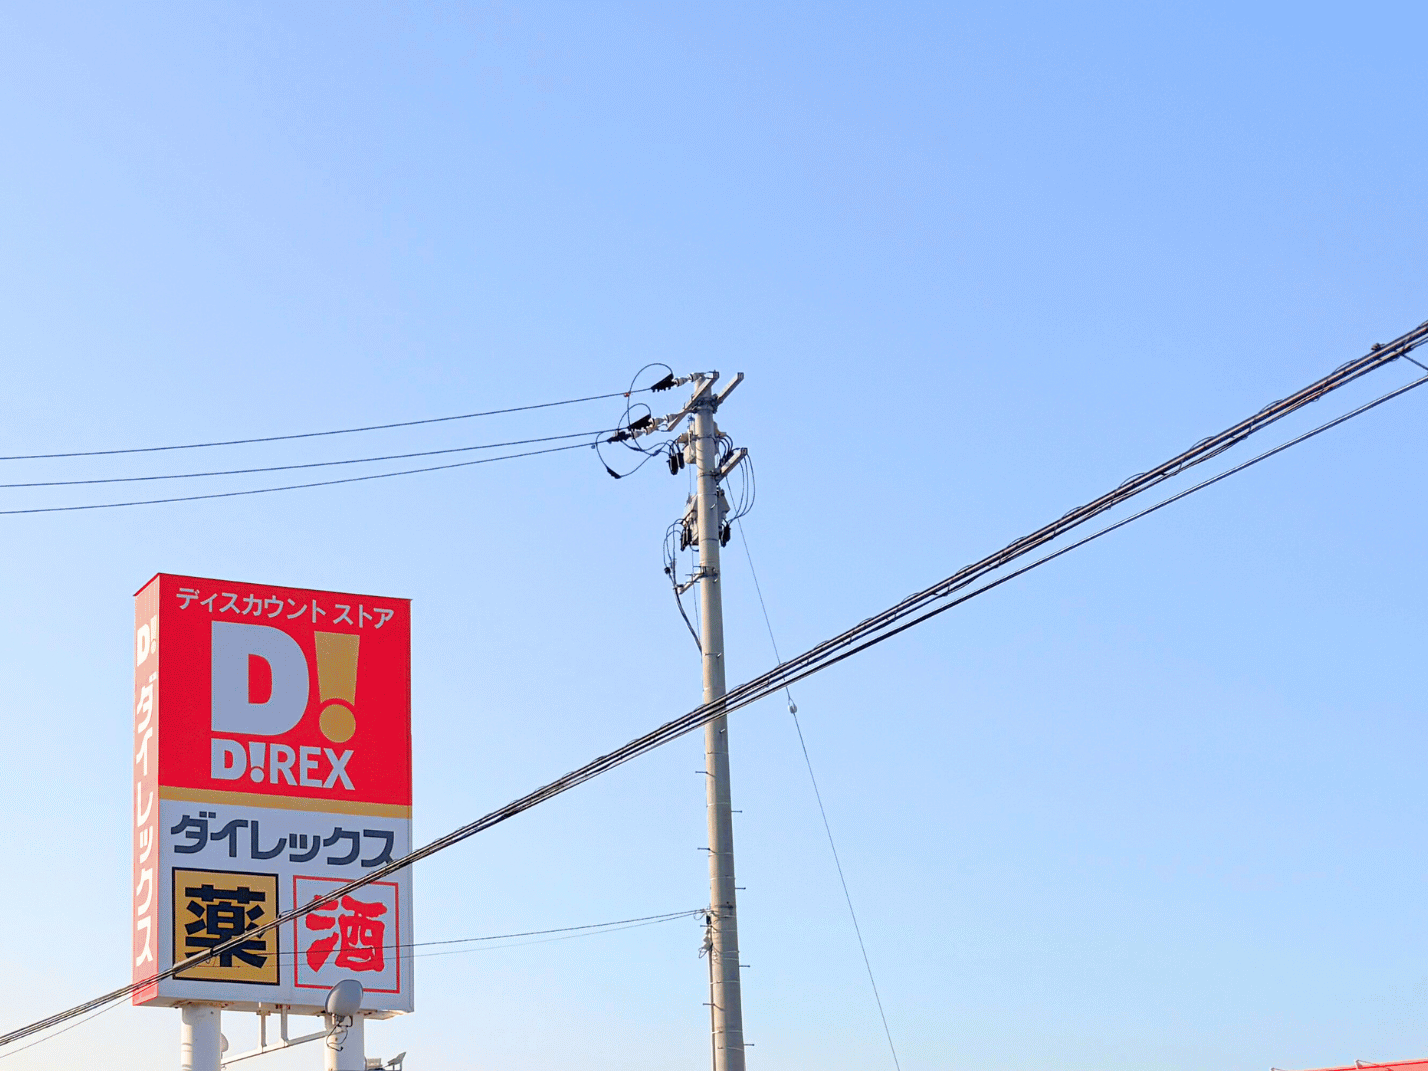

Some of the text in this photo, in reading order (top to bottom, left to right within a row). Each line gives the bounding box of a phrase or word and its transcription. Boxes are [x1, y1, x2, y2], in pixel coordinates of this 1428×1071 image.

[176, 588, 394, 629] ディスカウント ストア
[211, 620, 360, 743] D!
[136, 672, 157, 967] ダイレックス
[171, 811, 394, 868] ダイレックス
[185, 884, 267, 969] 薬
[306, 895, 387, 972] 酒
